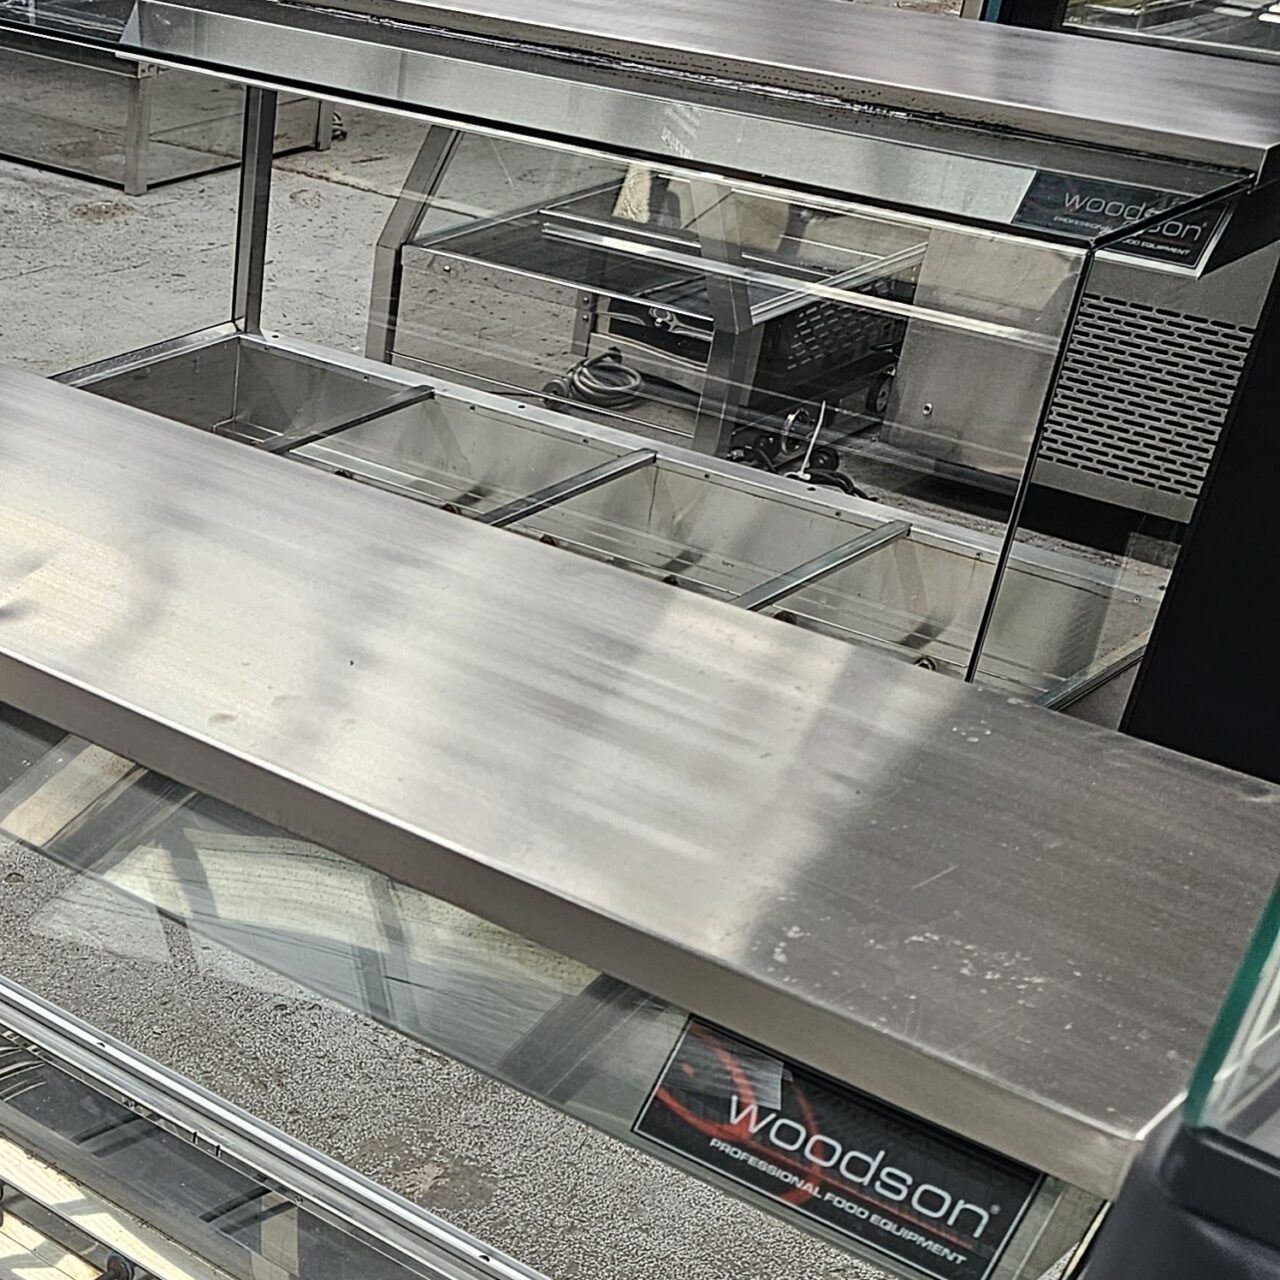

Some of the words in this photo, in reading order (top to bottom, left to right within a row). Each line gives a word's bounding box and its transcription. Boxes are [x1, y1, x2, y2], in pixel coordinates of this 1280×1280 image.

[709, 1137, 822, 1198] PROFESSIONAL
[823, 1191, 870, 1220] FOOD
[869, 1213, 968, 1265] EQUIPMENT
